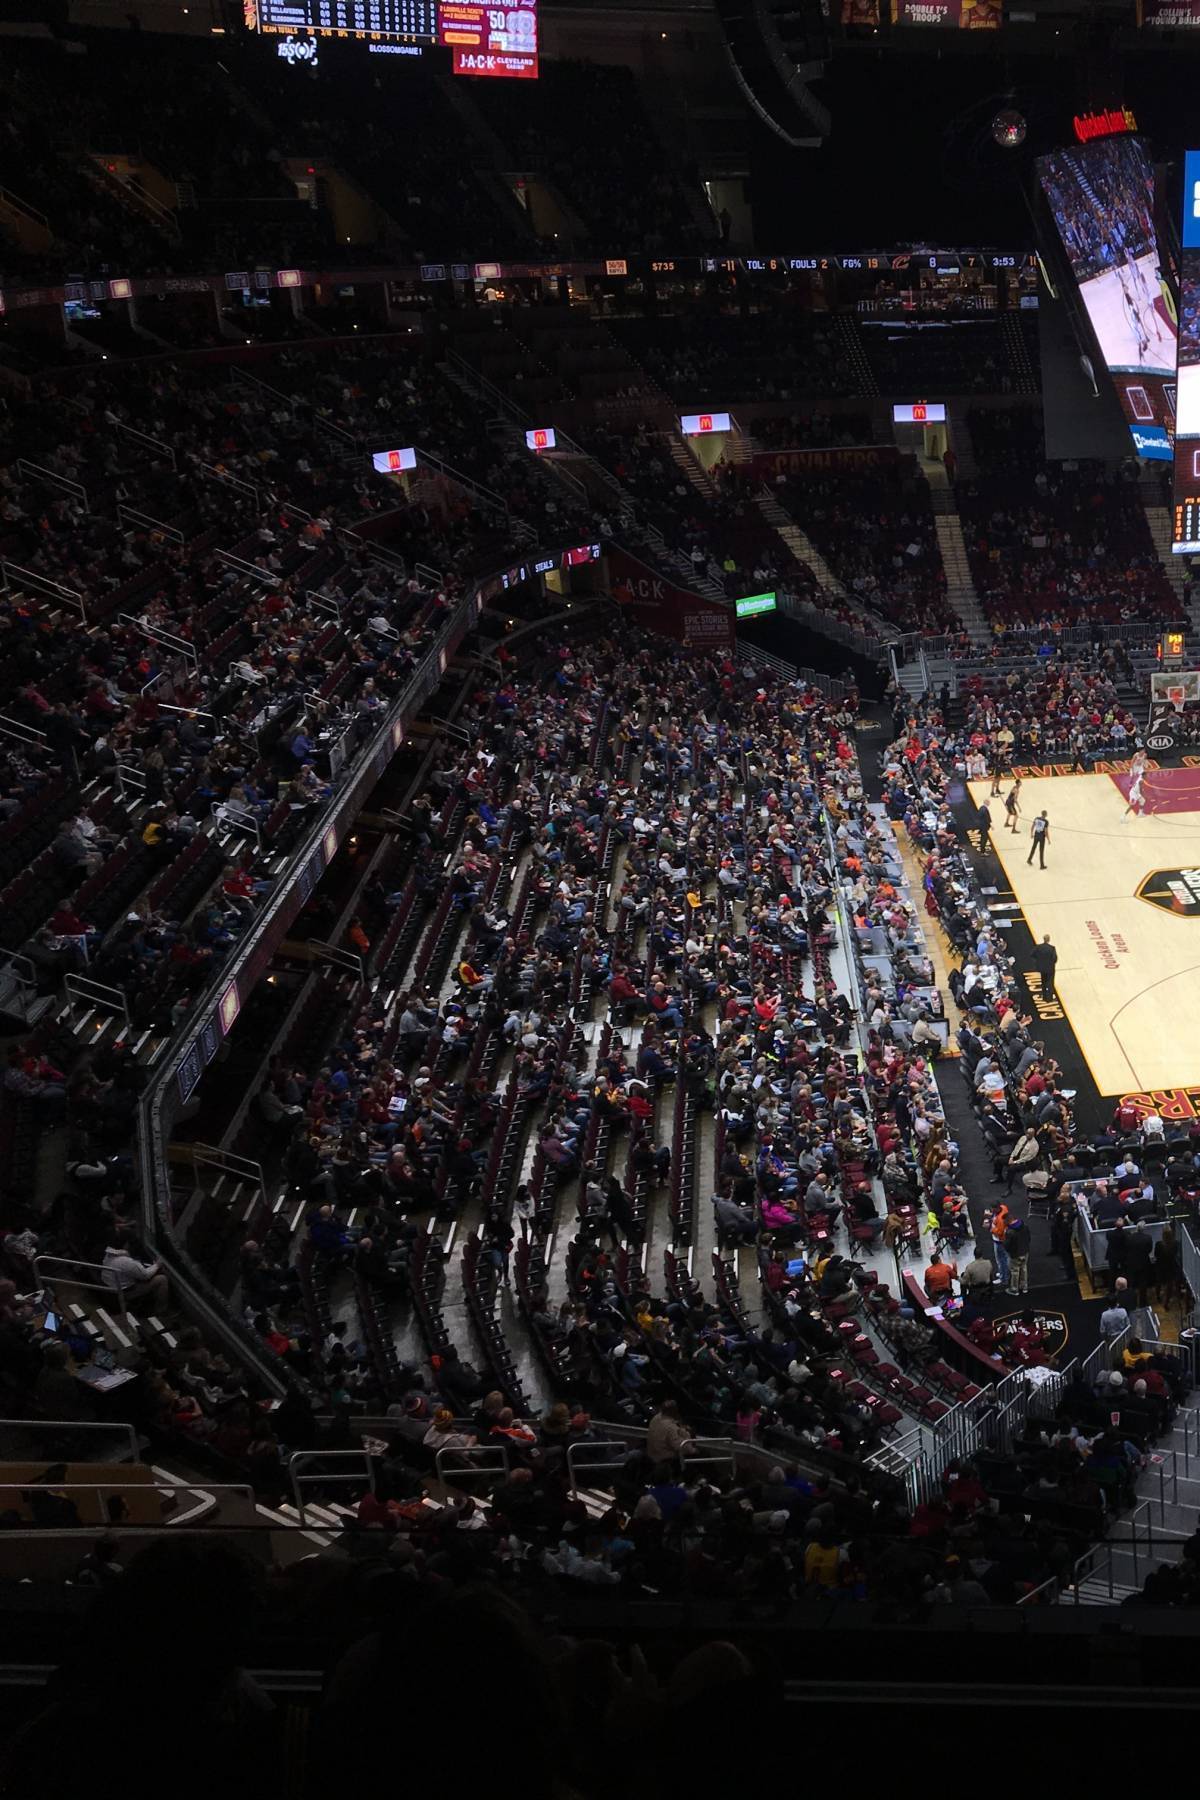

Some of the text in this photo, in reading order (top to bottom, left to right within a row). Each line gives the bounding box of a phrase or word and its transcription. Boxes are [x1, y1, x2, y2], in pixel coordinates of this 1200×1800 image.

[905, 4, 934, 14] DOUBLE
[1159, 8, 1192, 17] COLLIN'S
[912, 13, 942, 22] TROOPS
[652, 262, 675, 271] $735
[747, 260, 766, 270] TOL:
[790, 259, 817, 269] FOULS
[820, 260, 829, 269] 2
[842, 258, 861, 268] FG%
[929, 257, 937, 268] 8
[992, 257, 1015, 267] 3:53
[535, 560, 554, 573] STEALS
[684, 615, 729, 625] EPIC STORIES
[1151, 738, 1169, 747] KIA
[1085, 920, 1121, 970] Quicken Loans
[1111, 933, 1130, 953] Arena
